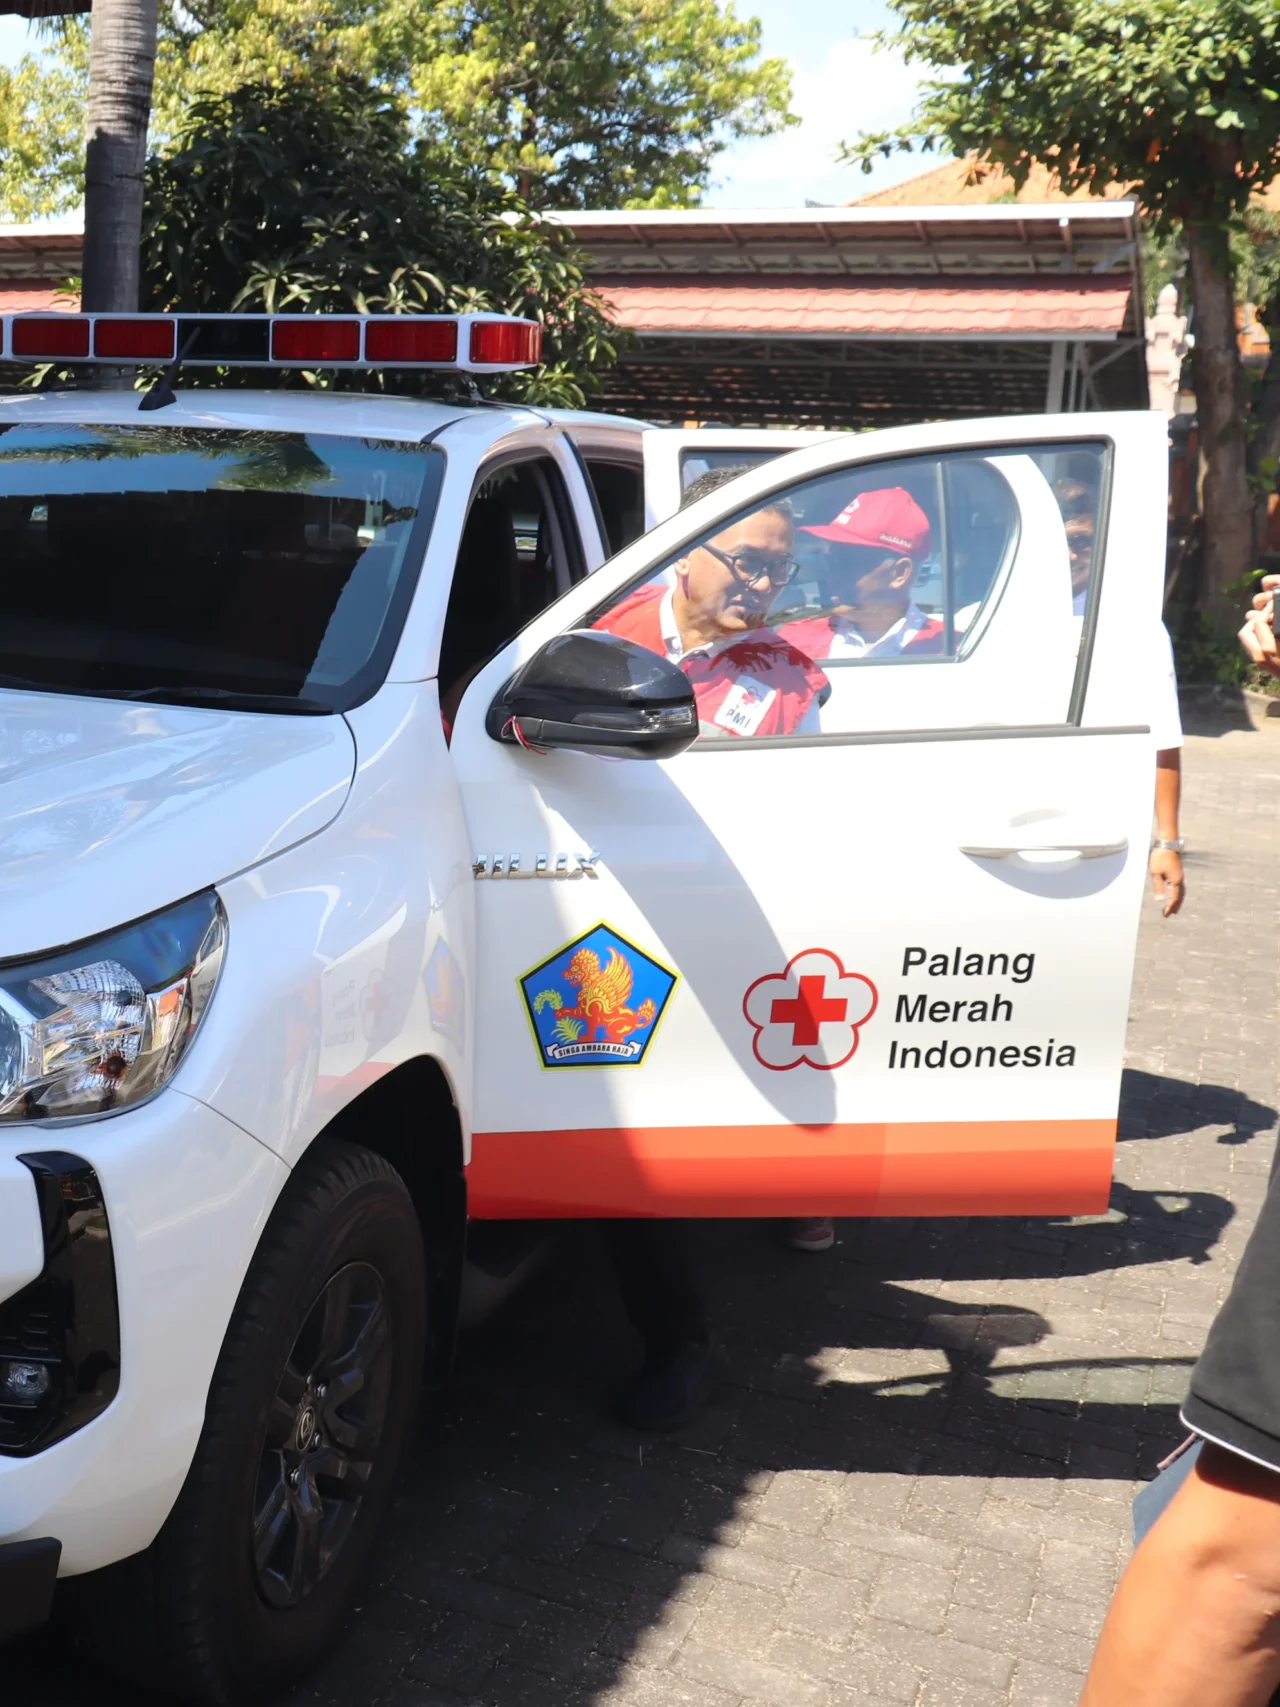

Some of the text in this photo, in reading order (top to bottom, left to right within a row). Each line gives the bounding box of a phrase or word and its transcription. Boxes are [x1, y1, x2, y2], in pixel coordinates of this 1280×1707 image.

[725, 707, 752, 729] PMI
[901, 946, 1036, 984] Palang
[894, 993, 1014, 1023] Merah
[557, 1043, 629, 1058] SINGA AMBARA RAJA
[888, 1038, 1077, 1069] Indonesia
